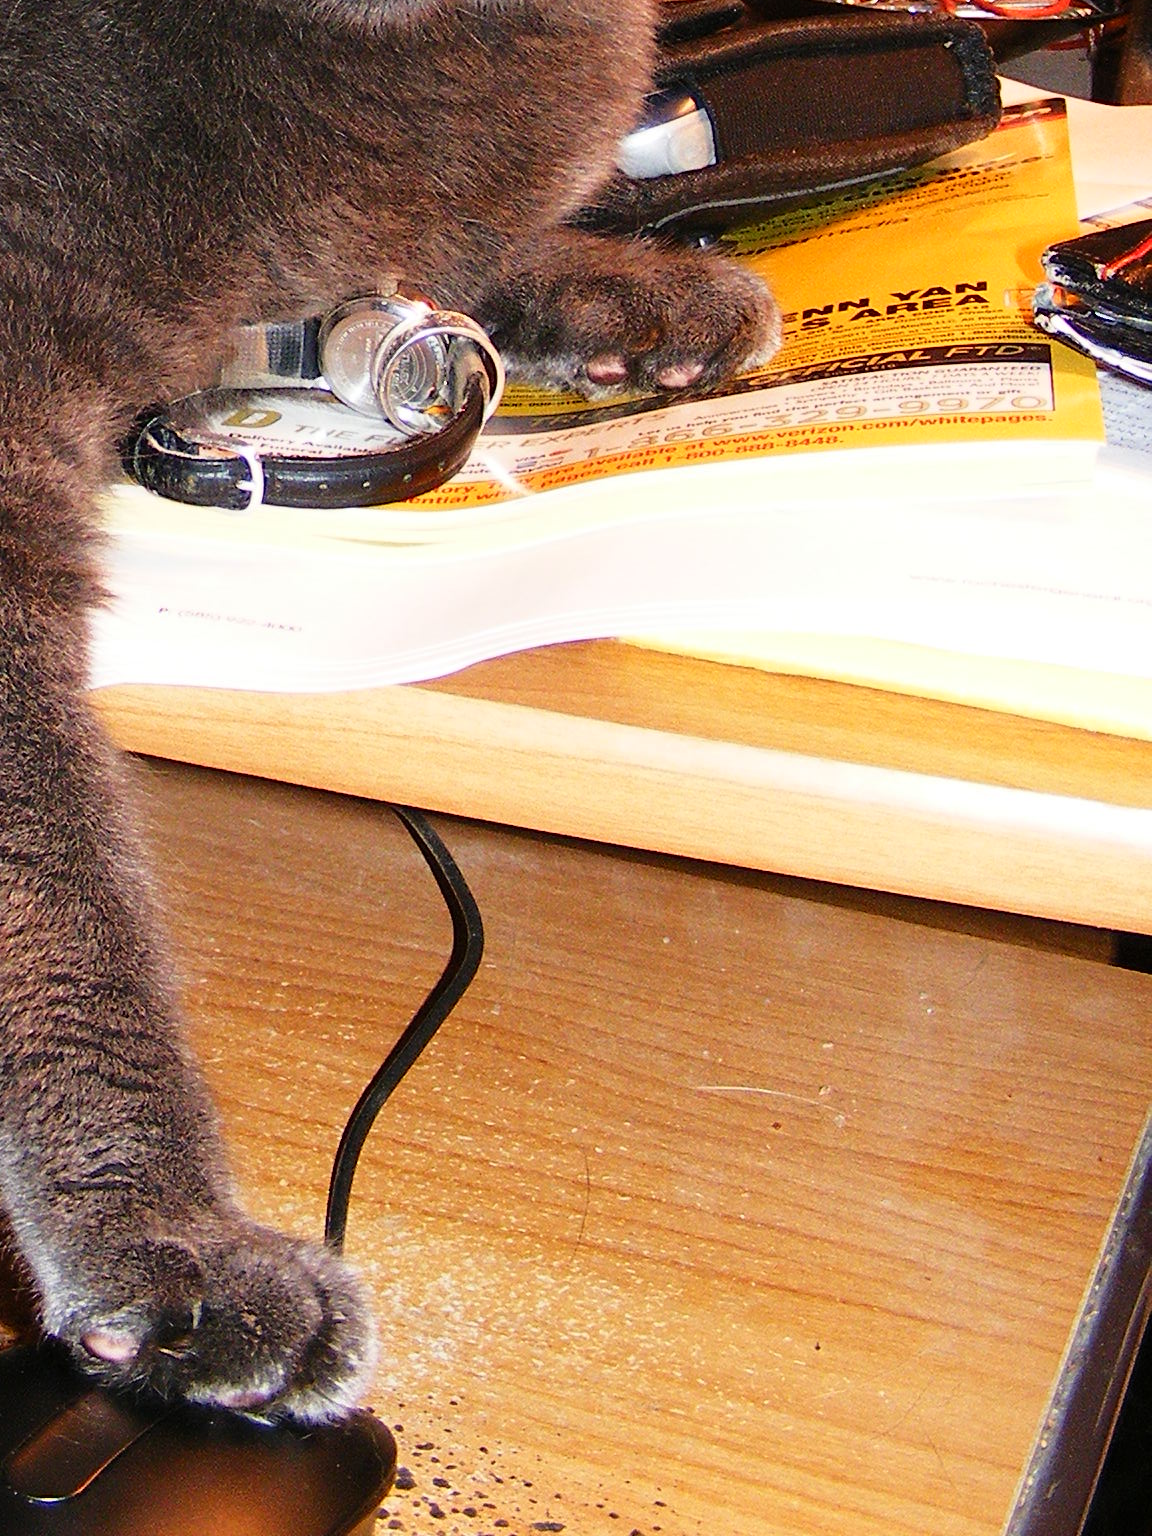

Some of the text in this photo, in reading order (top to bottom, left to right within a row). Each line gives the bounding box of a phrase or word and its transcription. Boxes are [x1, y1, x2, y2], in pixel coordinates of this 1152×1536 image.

[781, 281, 988, 325] ENN YAN
[850, 294, 990, 322] AREA
[946, 344, 1026, 360] FTD
[583, 446, 677, 469] available
[685, 441, 704, 450] at
[616, 453, 654, 470] call
